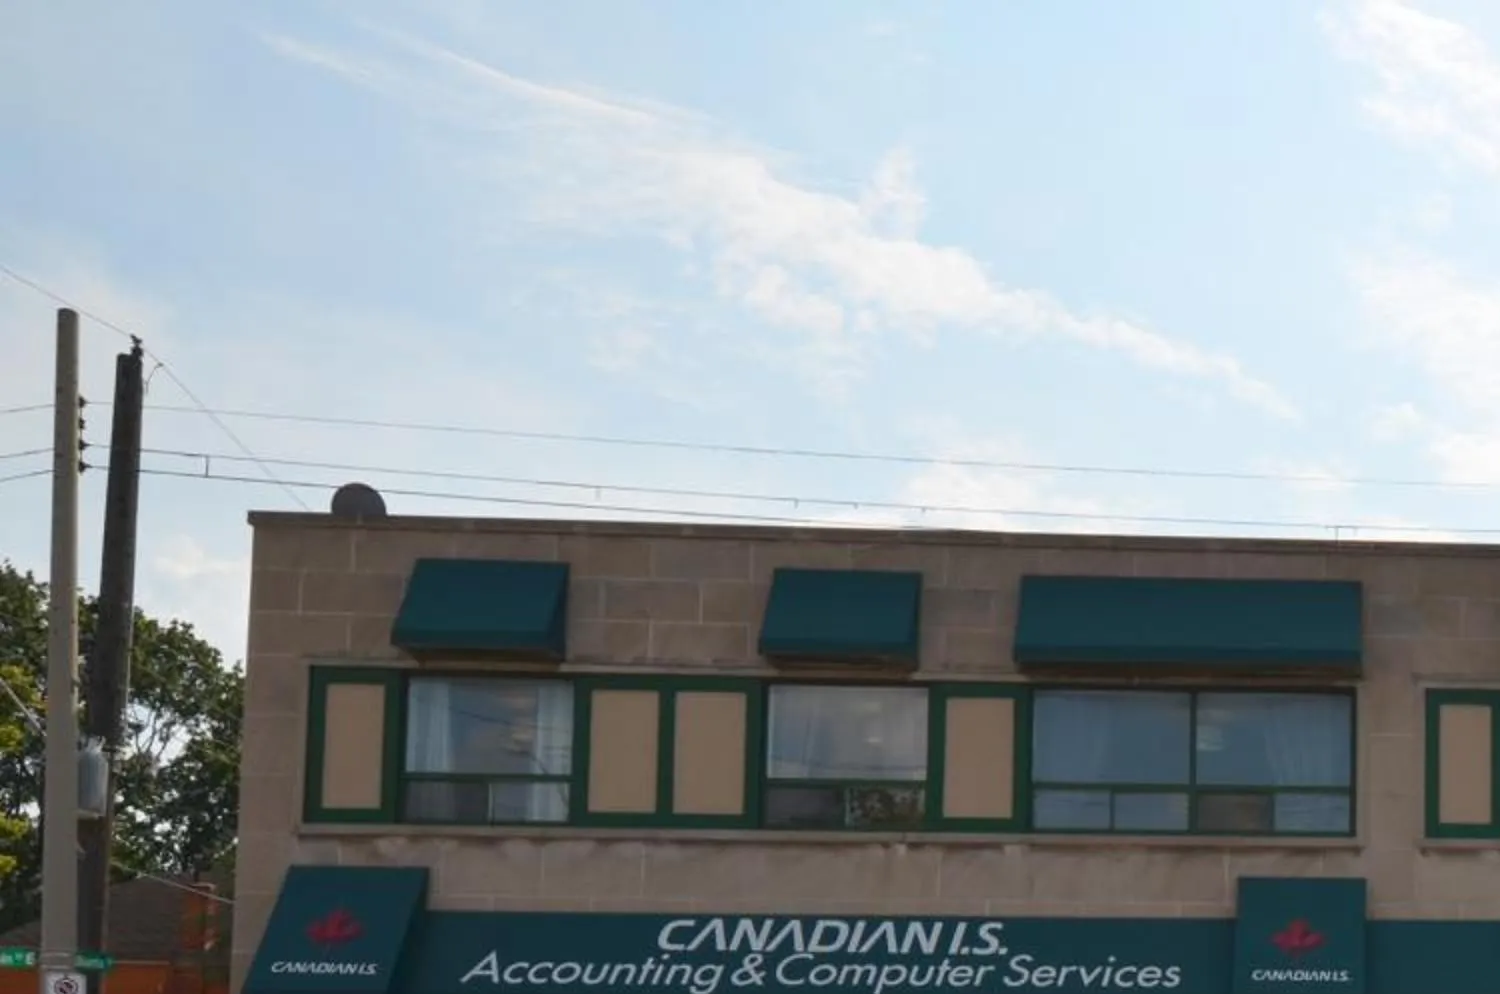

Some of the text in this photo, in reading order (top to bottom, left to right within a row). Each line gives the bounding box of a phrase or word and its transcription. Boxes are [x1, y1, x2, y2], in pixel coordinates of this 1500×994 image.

[658, 917, 1008, 955] CANADIAN I.S.
[271, 961, 359, 975] CANADIAN
[730, 953, 766, 986] &
[1003, 954, 1181, 988] Services
[1251, 968, 1330, 982] CANADIAN
